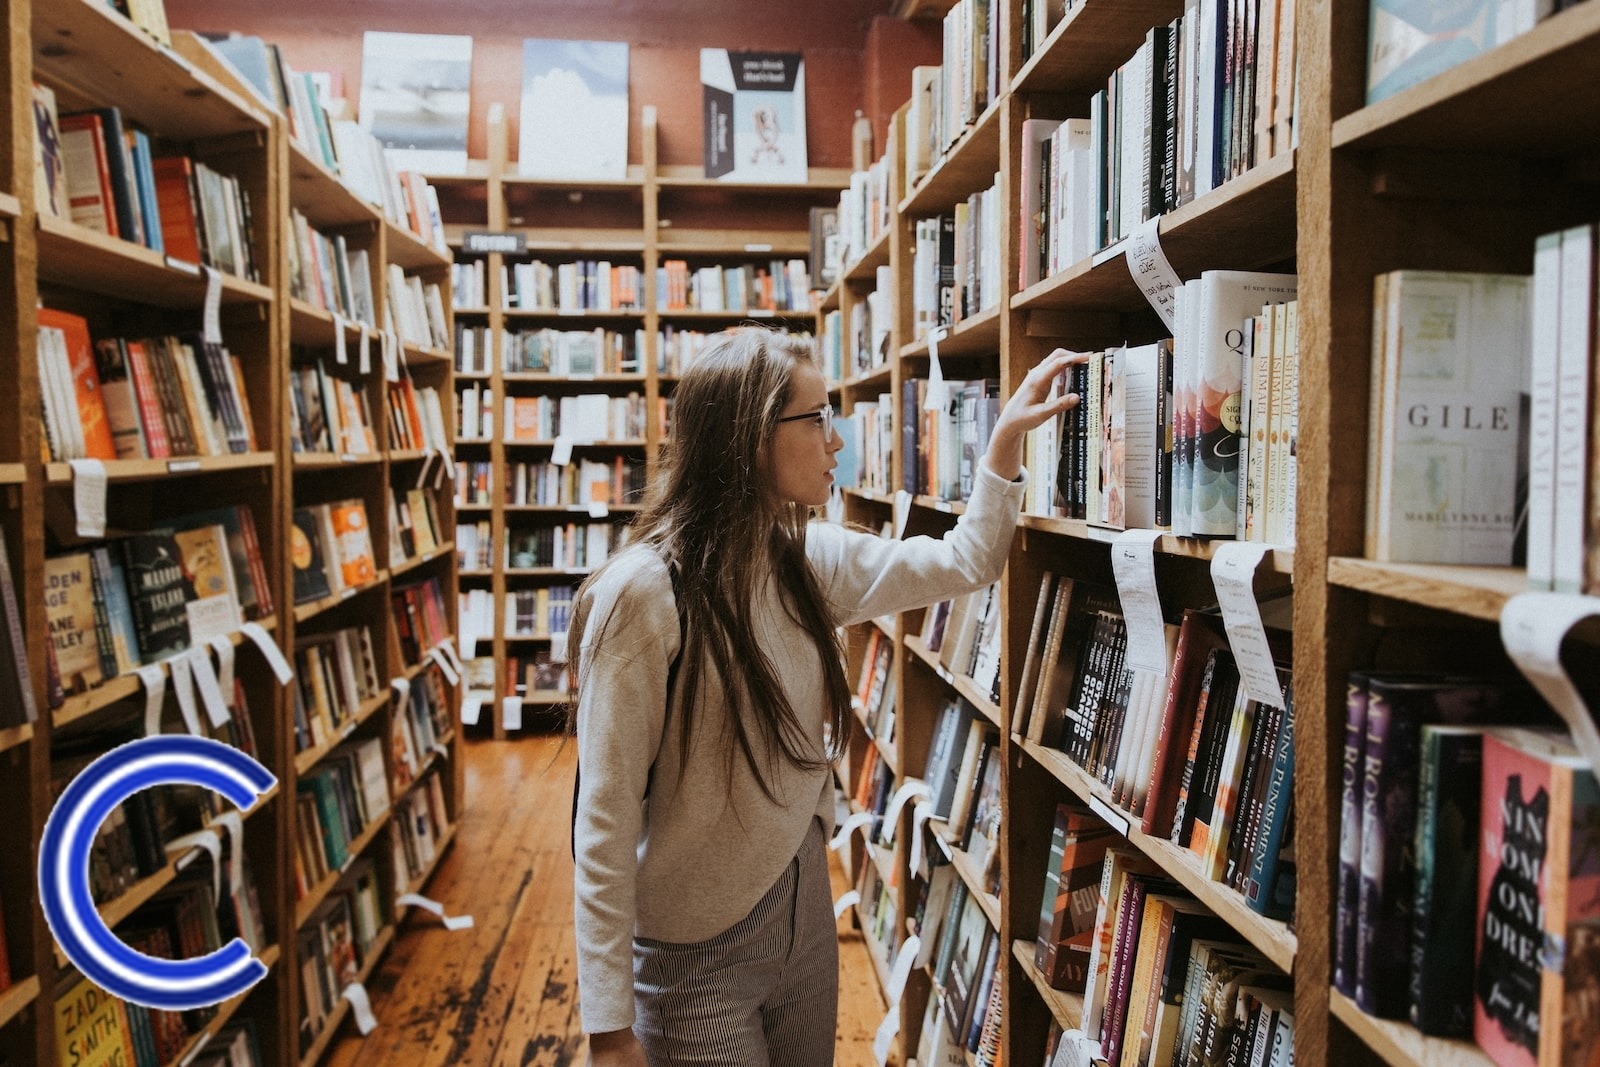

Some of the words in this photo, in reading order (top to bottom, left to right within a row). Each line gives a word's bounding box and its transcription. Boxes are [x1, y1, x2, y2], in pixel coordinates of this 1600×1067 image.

[1168, 30, 1176, 73] THOMAS
[1144, 82, 1152, 129] PYNCHON
[1166, 74, 1174, 121] PYNCHON
[1142, 135, 1151, 182] BLEEDING
[1165, 128, 1174, 174] BLEEDING
[1164, 178, 1173, 203] EDGE
[1257, 356, 1269, 418] ISHMAEL
[1271, 357, 1282, 421] ISHMAEL
[1282, 355, 1294, 417] ISHMAEL
[1408, 404, 1508, 430] GILE
[1279, 485, 1287, 514] QUINN
[1170, 650, 1184, 678] Devil
[1168, 679, 1175, 689] in
[1079, 677, 1097, 737] OTARED
[1085, 681, 1103, 742] OTARED
[1158, 690, 1174, 741] Jerusalem
[1253, 720, 1263, 748] RAKHA
[1261, 736, 1270, 756] CAME
[1268, 740, 1276, 759] CAME
[1235, 780, 1251, 834] CROCODILES
[1254, 768, 1285, 874] PUNISHMENT
[1114, 894, 1127, 953] UNRESTORED
[1122, 901, 1136, 961] UNRESTORED
[1109, 956, 1118, 991] WOMAN
[1117, 965, 1127, 1000] WOMAN
[1151, 968, 1160, 990] RASH
[1202, 970, 1213, 998] THE
[1146, 992, 1155, 1026] READER
[1214, 981, 1224, 1007] THE
[1194, 1003, 1207, 1046] RISEN
[1204, 1014, 1218, 1057] RISEN
[1247, 1019, 1255, 1038] RON
[1259, 1012, 1269, 1030] THE
[1243, 1040, 1252, 1065] RASH
[1253, 1031, 1266, 1065] WORLD
